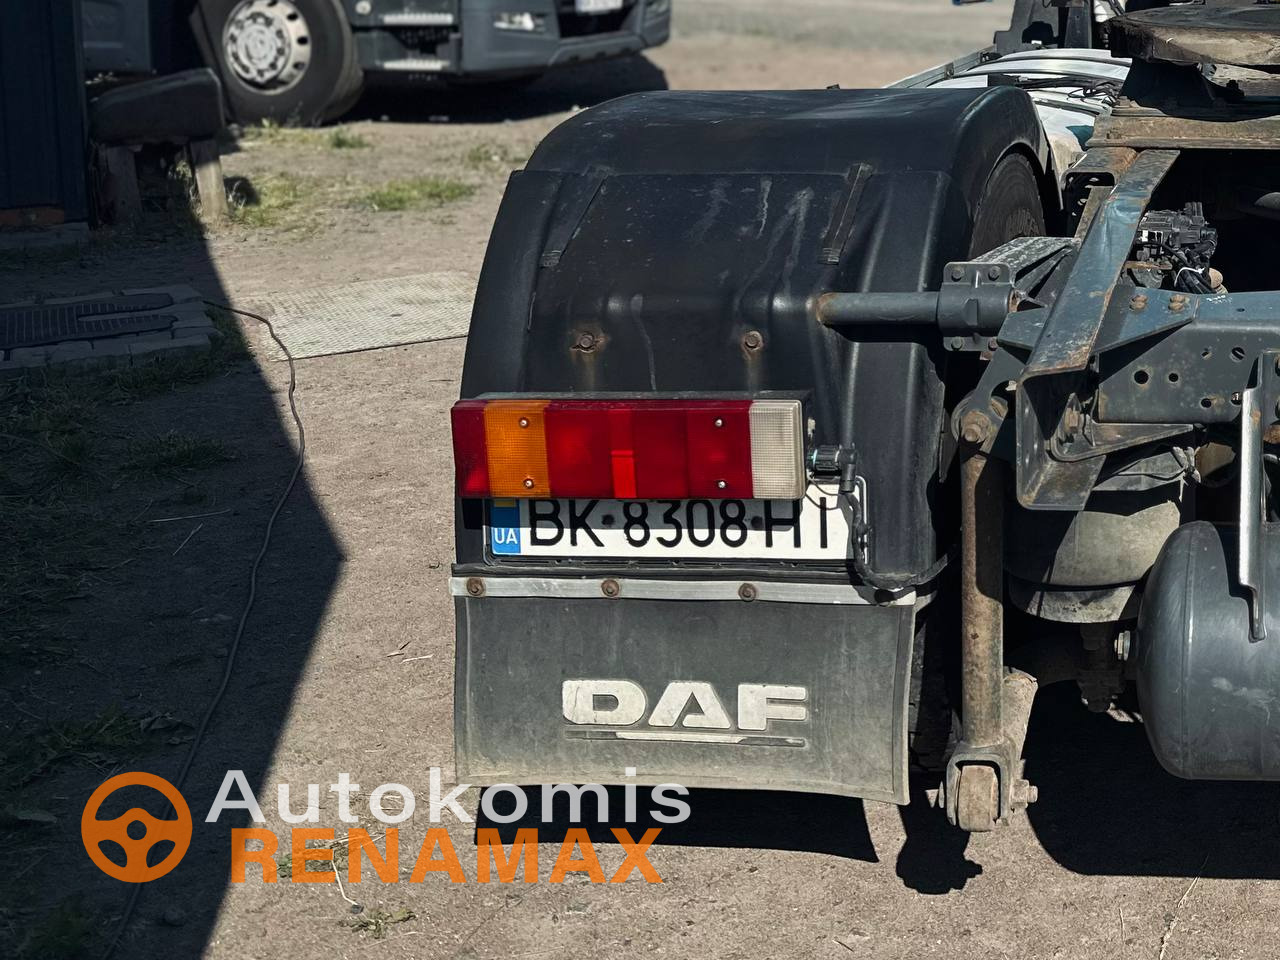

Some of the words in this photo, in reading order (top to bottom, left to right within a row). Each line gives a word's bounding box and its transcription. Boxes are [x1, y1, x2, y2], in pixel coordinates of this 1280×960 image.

[494, 527, 519, 545] UA
[529, 497, 604, 547] BK
[622, 497, 748, 549] 8308
[561, 679, 808, 732] DAF
